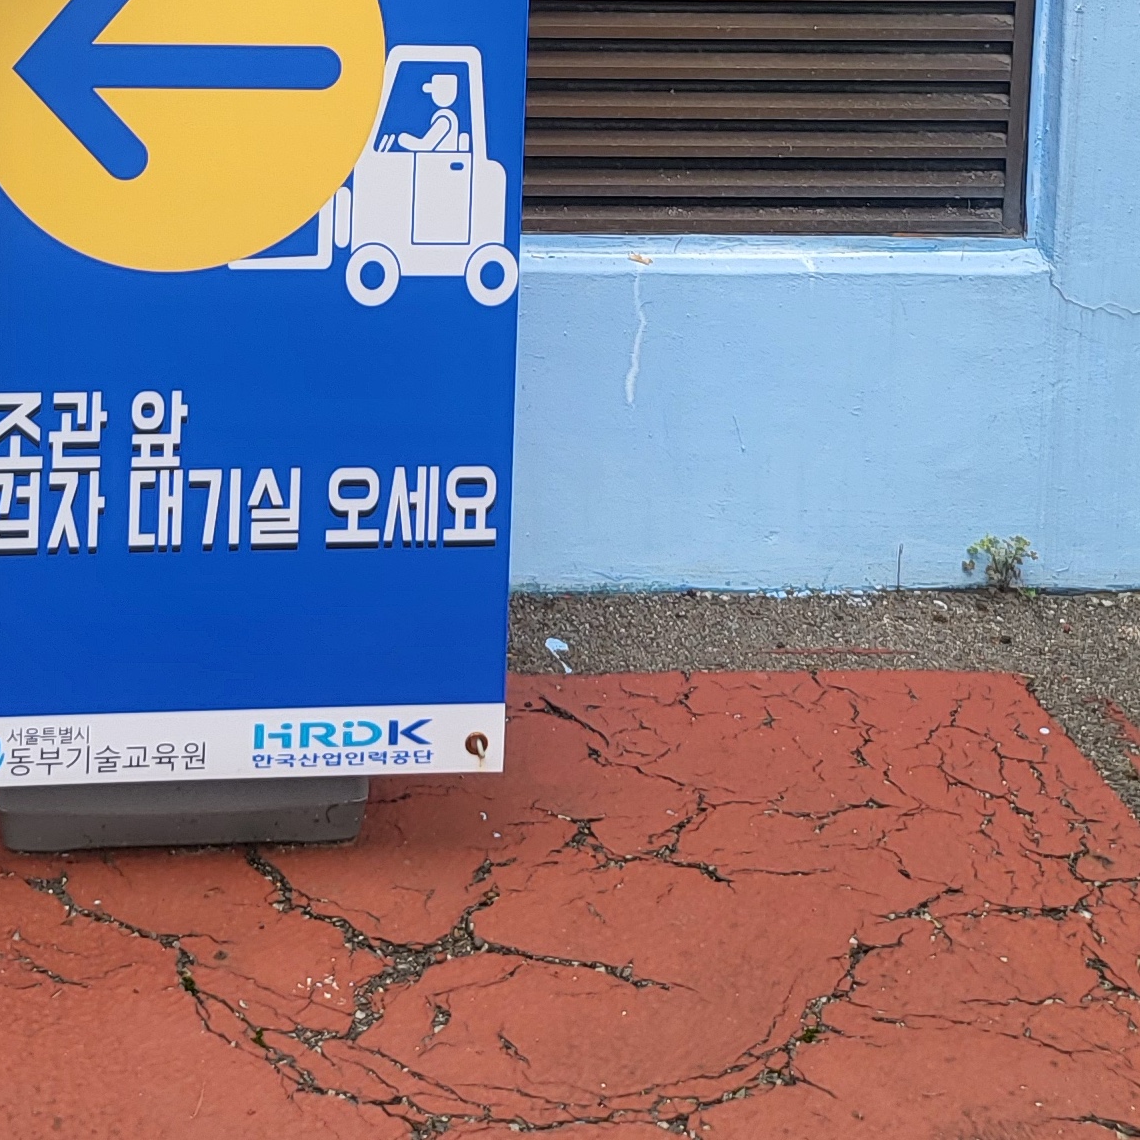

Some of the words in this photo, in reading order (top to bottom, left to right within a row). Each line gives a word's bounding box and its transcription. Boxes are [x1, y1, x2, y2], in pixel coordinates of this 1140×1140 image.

[131, 390, 188, 469] 앞
[128, 467, 301, 550] 대기실
[326, 465, 498, 548] 오세요
[6, 725, 90, 746] 서울특별시
[253, 718, 433, 750] HRDK
[6, 741, 206, 776] 동부기술교육원
[252, 749, 434, 769] 한국산업인력공단
